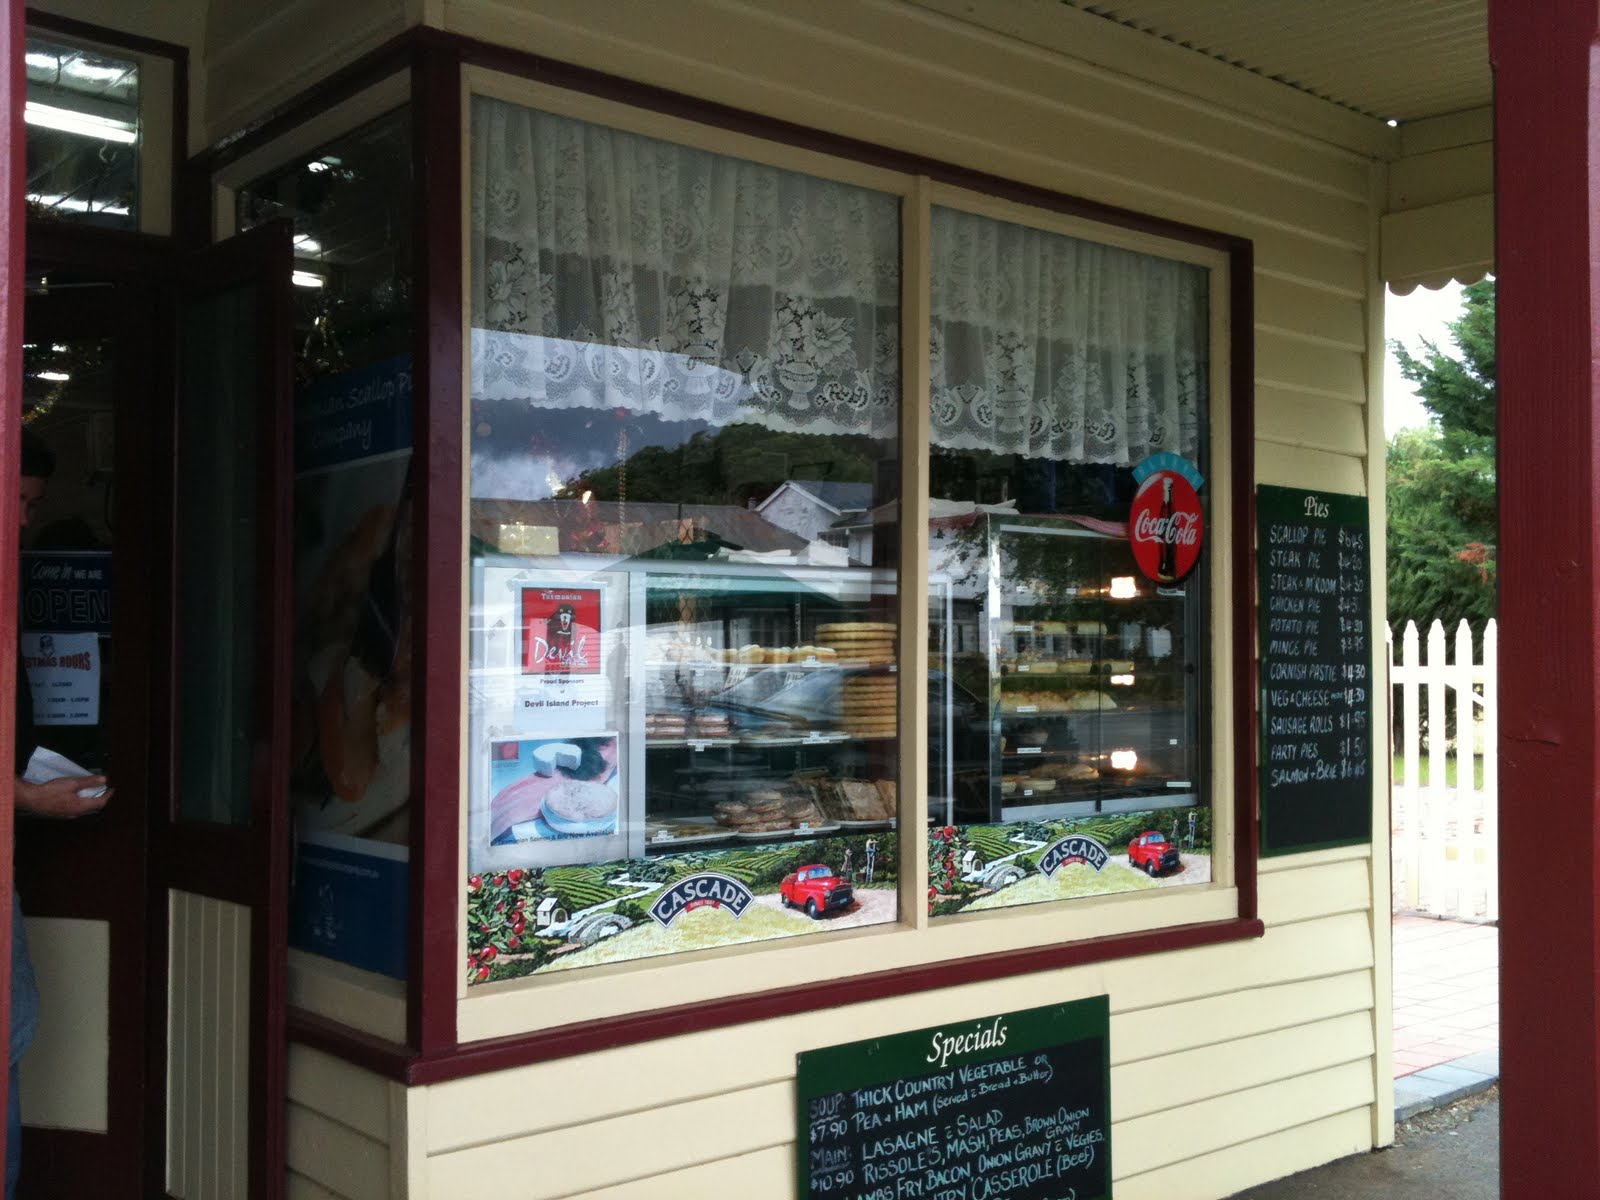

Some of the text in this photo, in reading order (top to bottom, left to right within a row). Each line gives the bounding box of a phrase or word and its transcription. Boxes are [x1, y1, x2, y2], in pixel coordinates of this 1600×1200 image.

[1304, 496, 1330, 518] Pies
[1134, 508, 1199, 545] Coca-Cola
[1269, 524, 1308, 544] SCALLOP
[1313, 527, 1327, 545] PIE
[1269, 549, 1301, 568] STEAK
[1307, 551, 1321, 570] PIE
[74, 569, 87, 579] WE
[88, 569, 103, 580] ARE
[1270, 573, 1298, 591] STEAK
[25, 589, 111, 624] OPEN
[1269, 596, 1304, 613] CHICKEN
[1307, 596, 1321, 614] PIE
[1269, 618, 1303, 634] POTATO
[1305, 619, 1320, 635] PIE
[534, 635, 588, 664] Devil
[1269, 639, 1300, 657] MINCE
[1304, 640, 1319, 657] PIE
[59, 651, 92, 671] HOURS
[1270, 662, 1307, 681] CORNISH
[525, 700, 544, 708] Devil
[572, 700, 599, 708] Project
[1271, 689, 1289, 708] VEG
[1296, 690, 1330, 708] CHEESE
[1271, 716, 1308, 735] SAUSAGE
[1309, 715, 1333, 734] ROLLS
[1271, 744, 1297, 761] PARTY
[1300, 742, 1319, 760] PIES
[1271, 767, 1310, 788] SALMON
[1043, 840, 1104, 872] CASCADE
[657, 879, 746, 919] CASCADE
[926, 1016, 1008, 1068] Specials
[850, 1085, 894, 1109] THICK
[894, 1071, 955, 1101] COUNTRY
[959, 1057, 1027, 1085] VEGETABLE
[1034, 1054, 1048, 1066] OR
[850, 1111, 883, 1133] PEA
[894, 1101, 928, 1122] HAM
[978, 1077, 1011, 1095] Bread
[1023, 1114, 1057, 1135] BROWN
[1057, 1106, 1090, 1125] ONION
[1045, 1121, 1081, 1139] GRAVY
[862, 1126, 939, 1161] LASAGNE
[956, 1109, 1004, 1137] SALAD
[978, 1150, 1013, 1174] ONION
[1014, 1141, 1052, 1162] GRAVY
[1056, 1145, 1095, 1178] (Beef)
